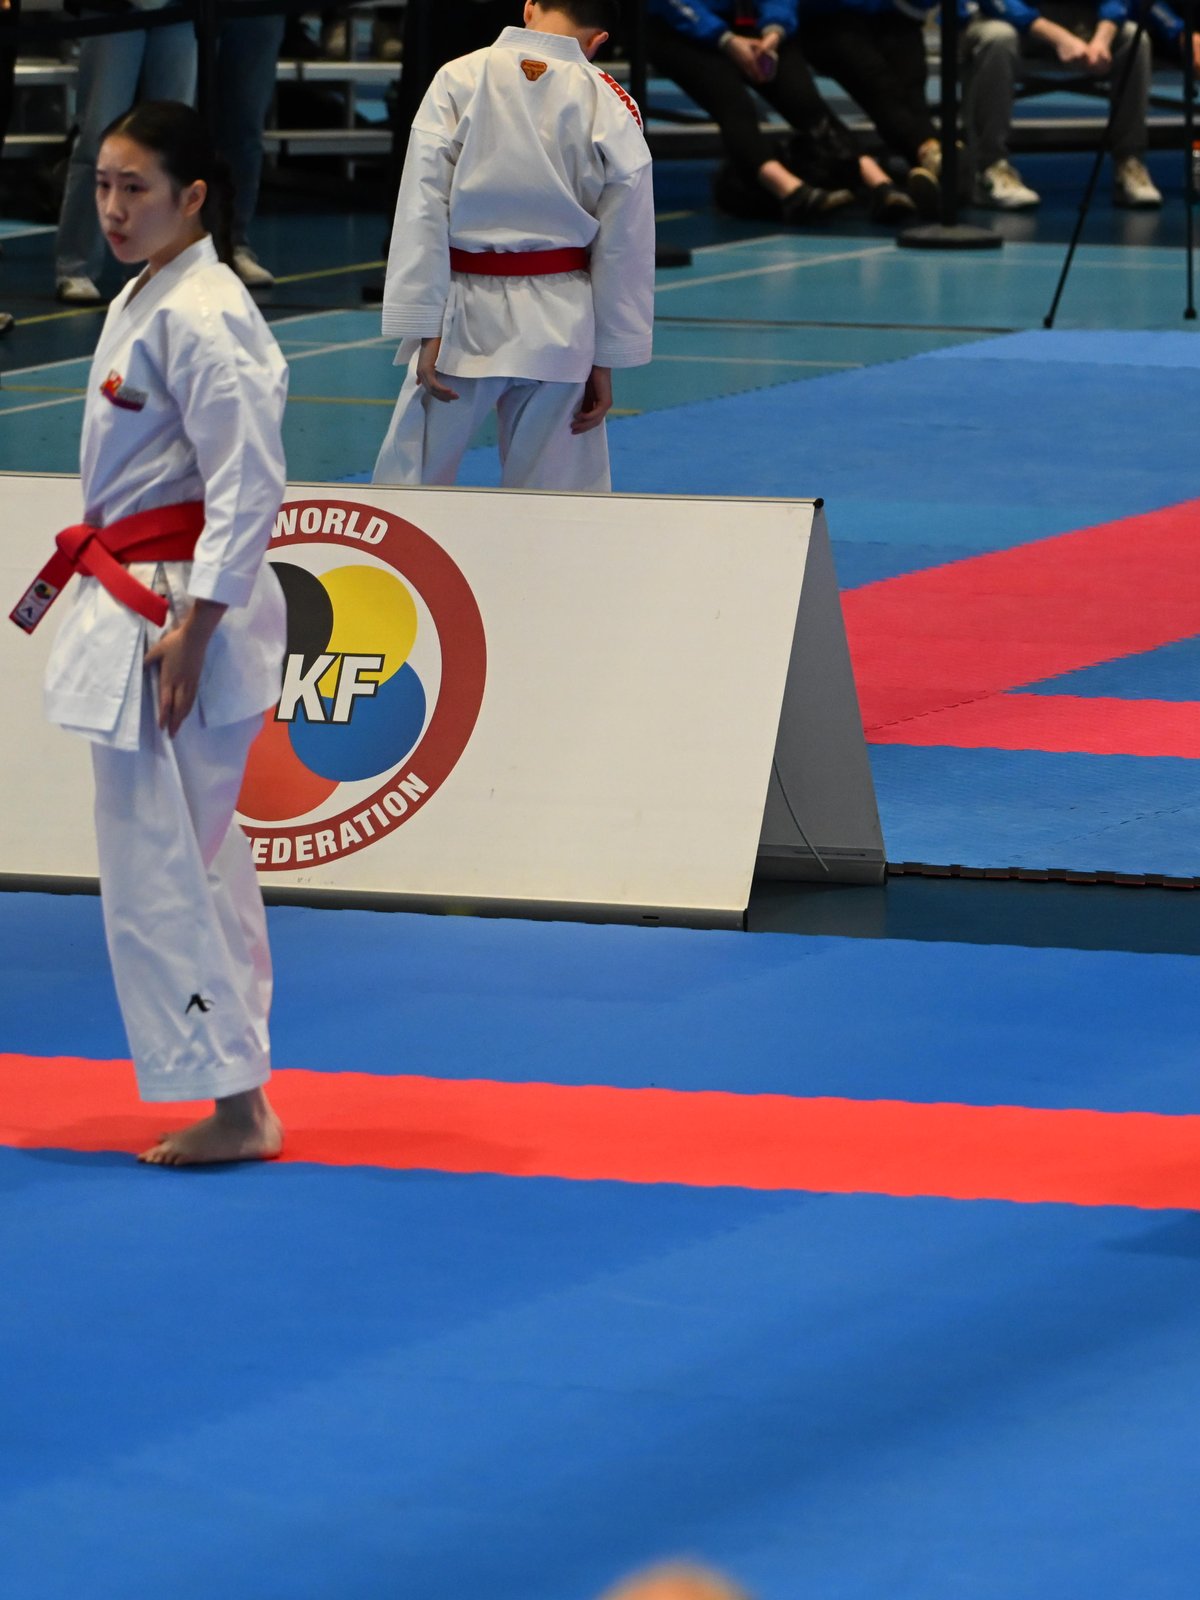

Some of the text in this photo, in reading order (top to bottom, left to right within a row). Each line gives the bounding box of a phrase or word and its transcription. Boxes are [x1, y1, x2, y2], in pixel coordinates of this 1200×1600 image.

[271, 507, 388, 545] WORLD
[275, 652, 384, 724] KF
[249, 772, 430, 864] EDERATION
